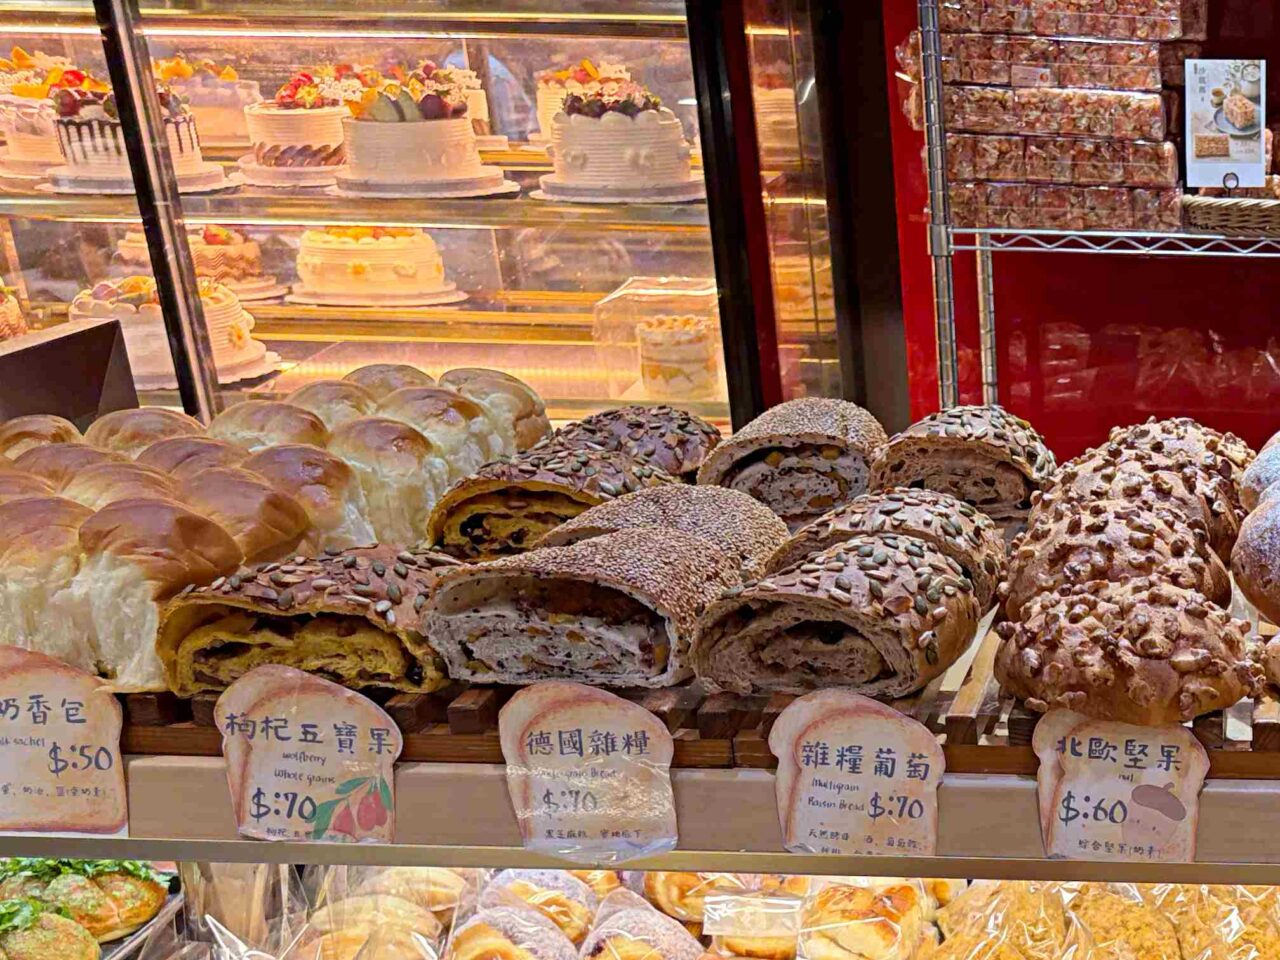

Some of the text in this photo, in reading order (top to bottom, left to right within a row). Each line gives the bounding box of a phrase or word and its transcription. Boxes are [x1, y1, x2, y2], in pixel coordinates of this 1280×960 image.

[225, 712, 394, 755] 枸杞五寶果
[526, 728, 651, 758] 德國雜糧
[801, 741, 931, 781] 雜糧葡萄
[1055, 735, 1183, 772] 北歐堅果
